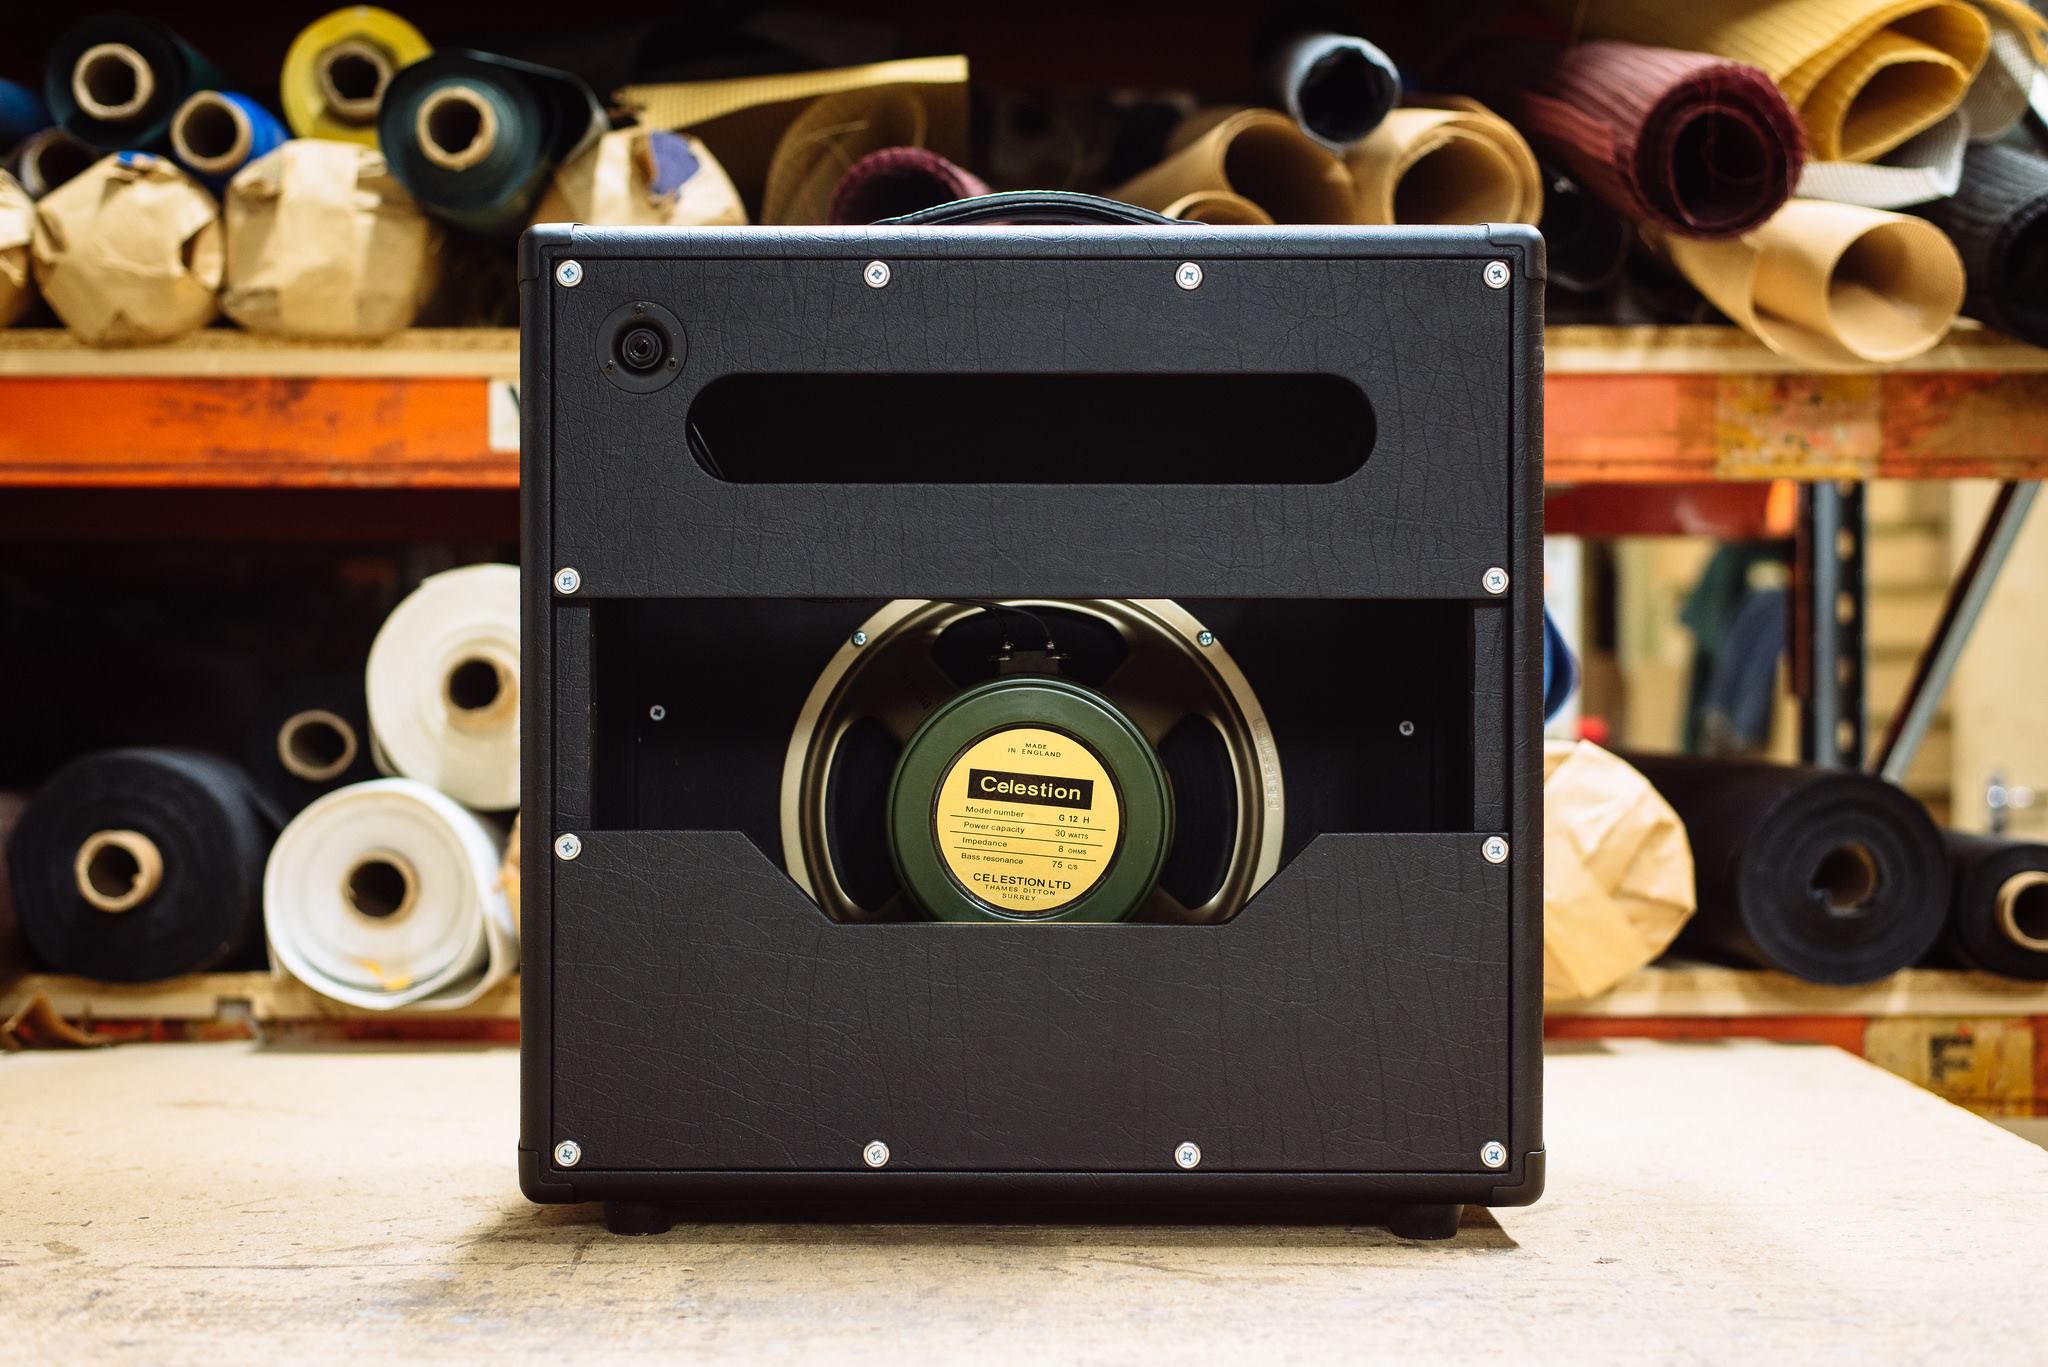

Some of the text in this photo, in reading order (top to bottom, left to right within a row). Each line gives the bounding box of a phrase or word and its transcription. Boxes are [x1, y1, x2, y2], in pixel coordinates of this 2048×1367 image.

[1025, 742, 1047, 750] MADE
[1022, 749, 1062, 758] ENGLAND
[980, 776, 1081, 800] Celestion
[965, 806, 992, 815] Model
[994, 809, 1024, 818] number
[1058, 814, 1065, 822] G
[1082, 816, 1090, 824] H
[964, 822, 1089, 840] Power capacity 30 WATTS
[962, 837, 1008, 848] Impedance
[961, 852, 981, 861] Bass
[983, 856, 1024, 865] resonance
[1052, 861, 1063, 869] 75
[972, 872, 1072, 890] CELESTION LTD
[984, 884, 1056, 896] THAMES DITTON
[1002, 893, 1036, 901] SURREY
